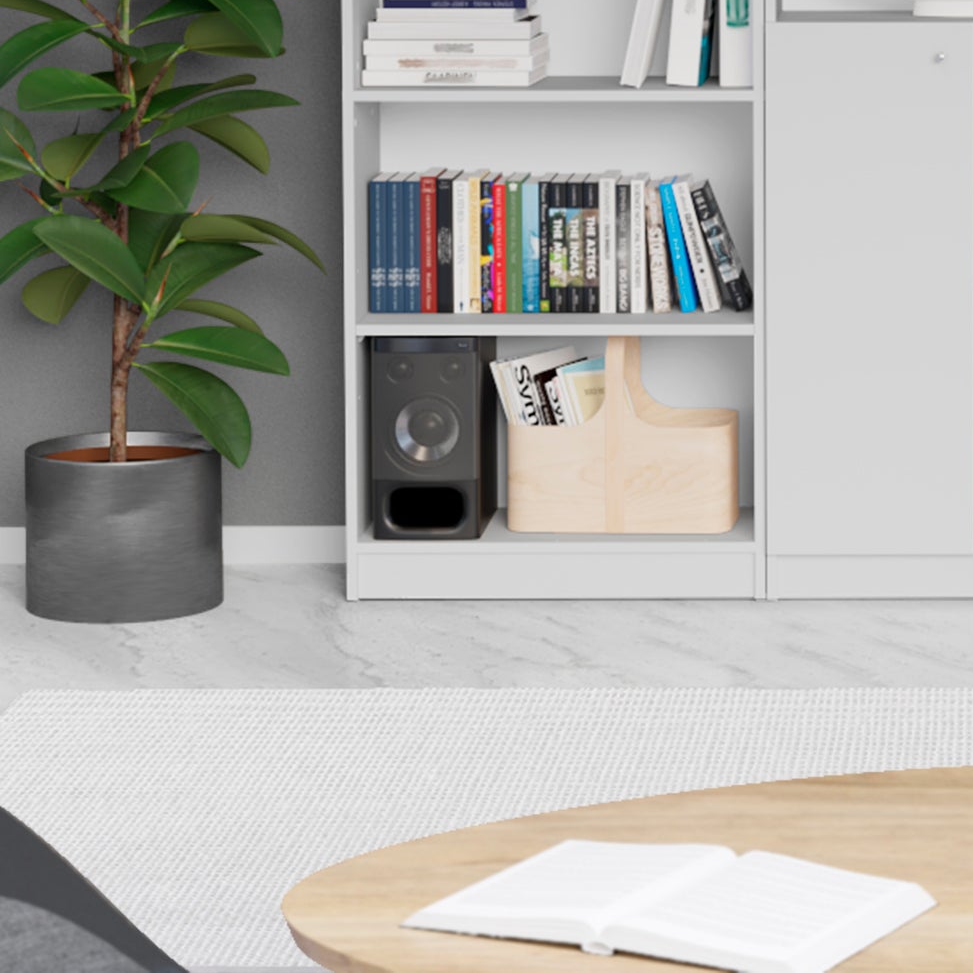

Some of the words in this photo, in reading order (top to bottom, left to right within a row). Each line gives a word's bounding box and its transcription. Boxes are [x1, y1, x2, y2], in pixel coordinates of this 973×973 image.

[552, 219, 563, 239] THE
[569, 219, 580, 240] THE
[586, 216, 597, 237] THE
[569, 241, 580, 277] INCAS
[586, 238, 597, 280] AZTECS
